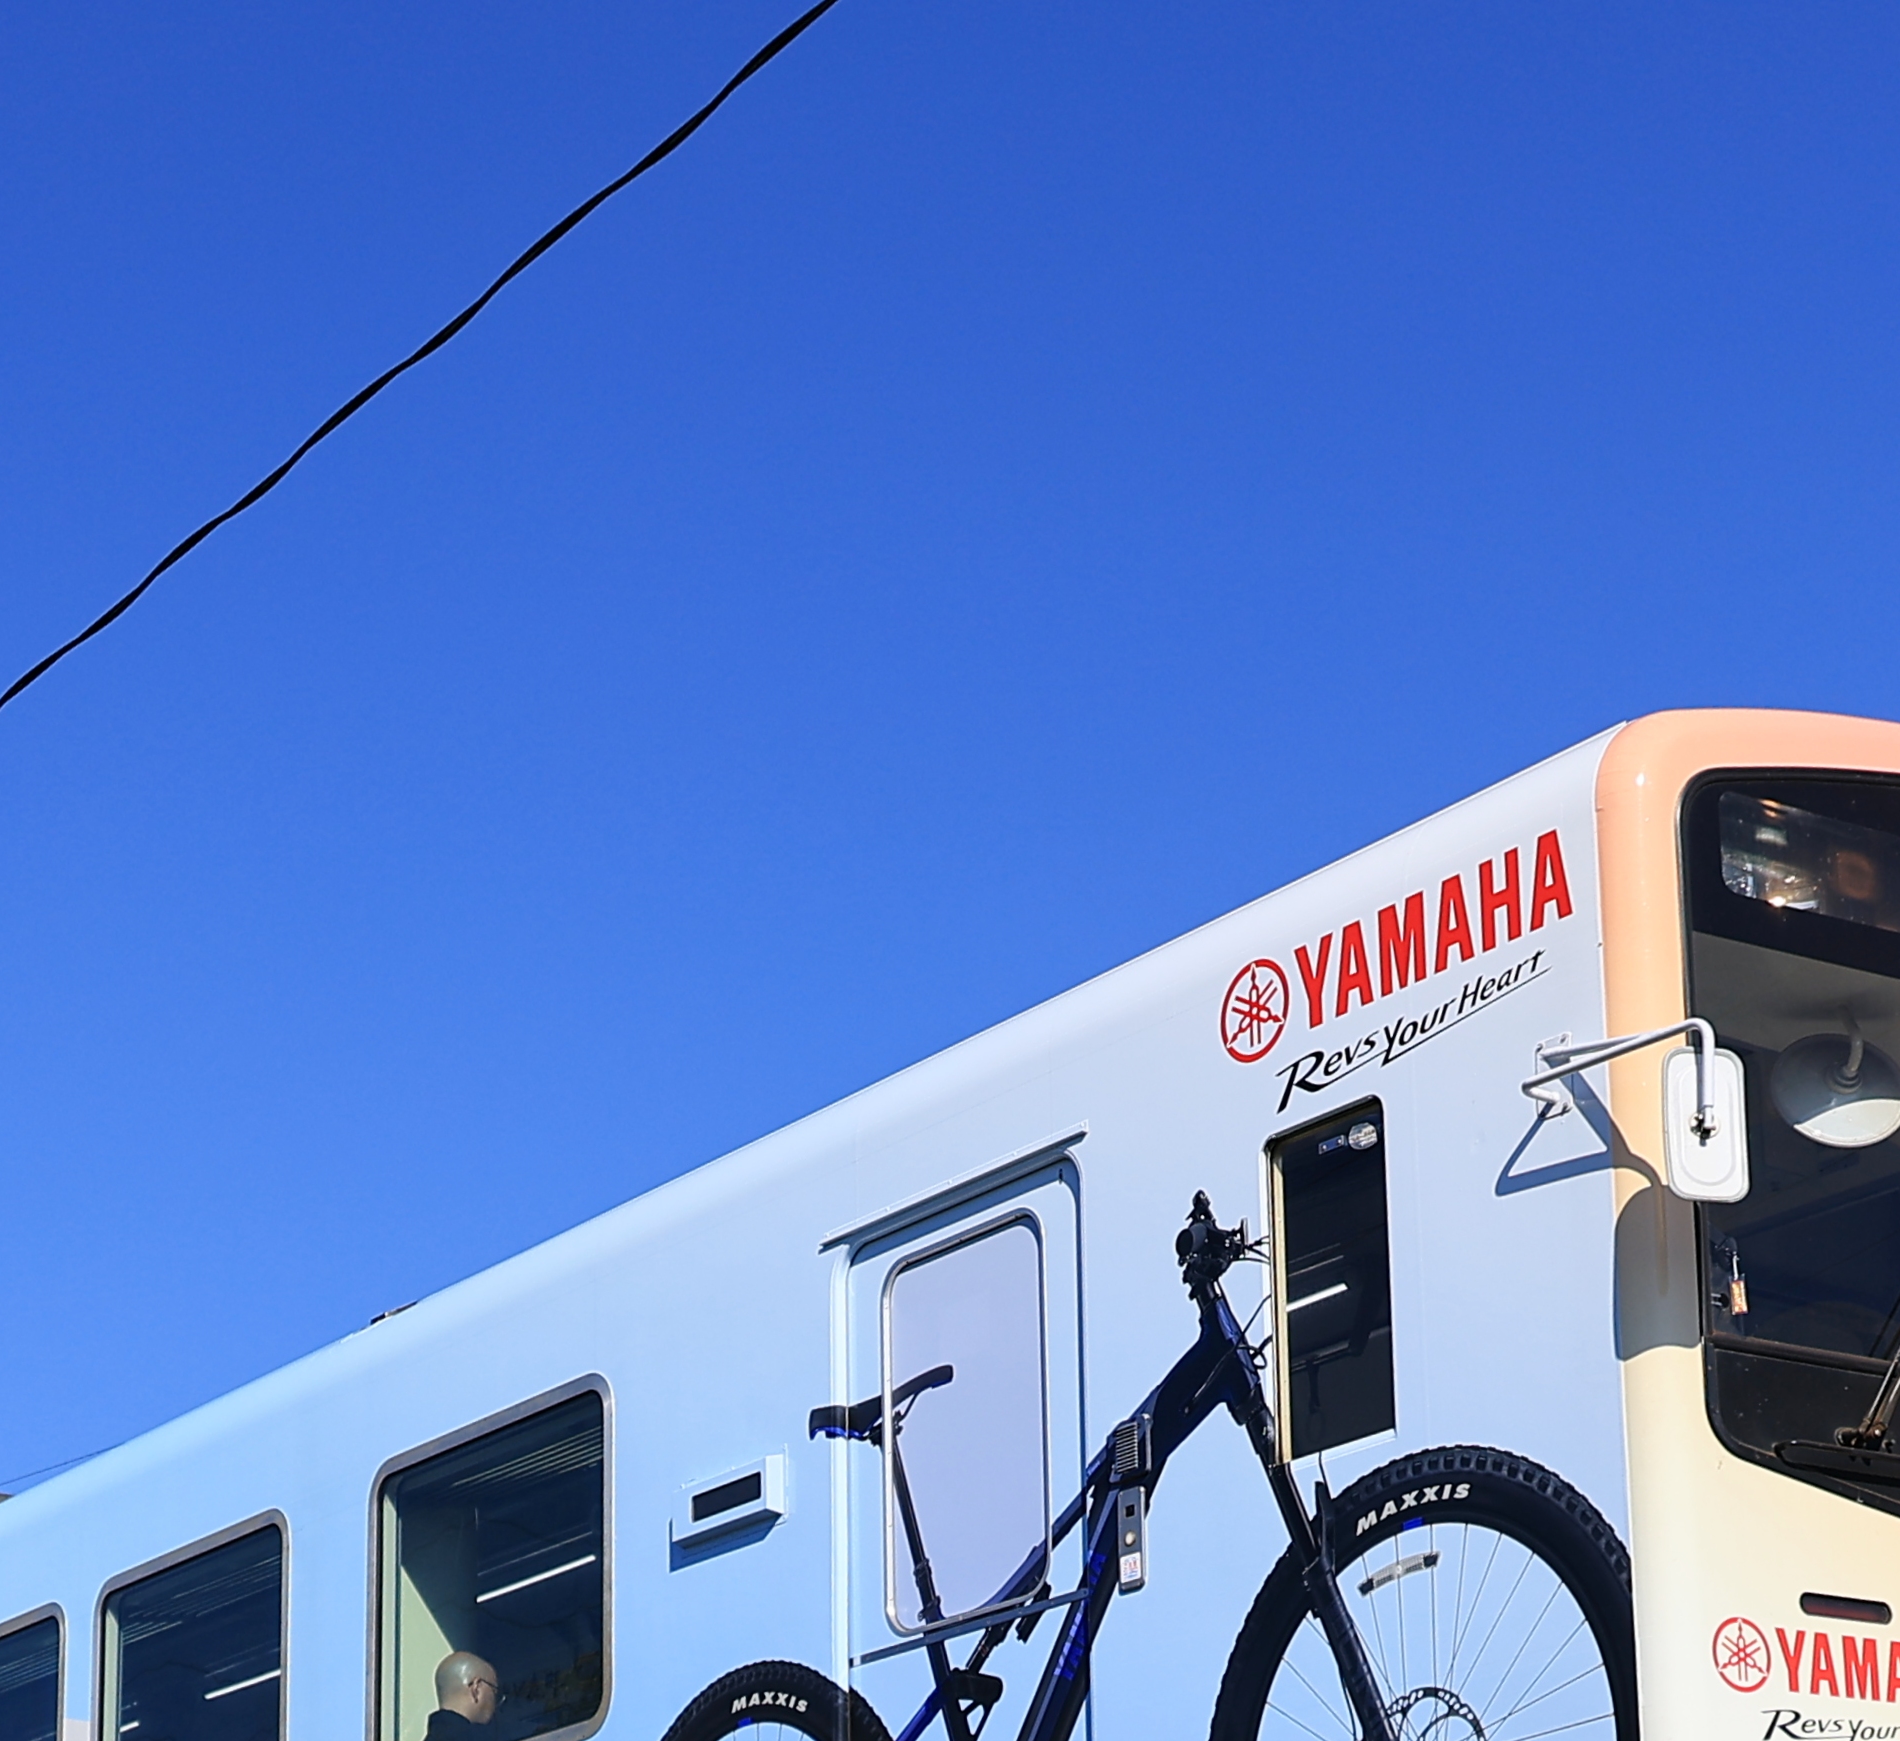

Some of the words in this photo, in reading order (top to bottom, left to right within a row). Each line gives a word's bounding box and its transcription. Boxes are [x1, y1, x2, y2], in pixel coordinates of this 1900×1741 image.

[1294, 829, 1574, 1029] YAMAHA
[1275, 1030, 1380, 1114] Revs
[1380, 998, 1456, 1067] Your
[1457, 949, 1547, 1015] Heart
[1356, 1483, 1471, 1536] MAXXIS
[731, 1691, 809, 1714] MAXXIS
[1761, 1709, 1845, 1741] Revs
